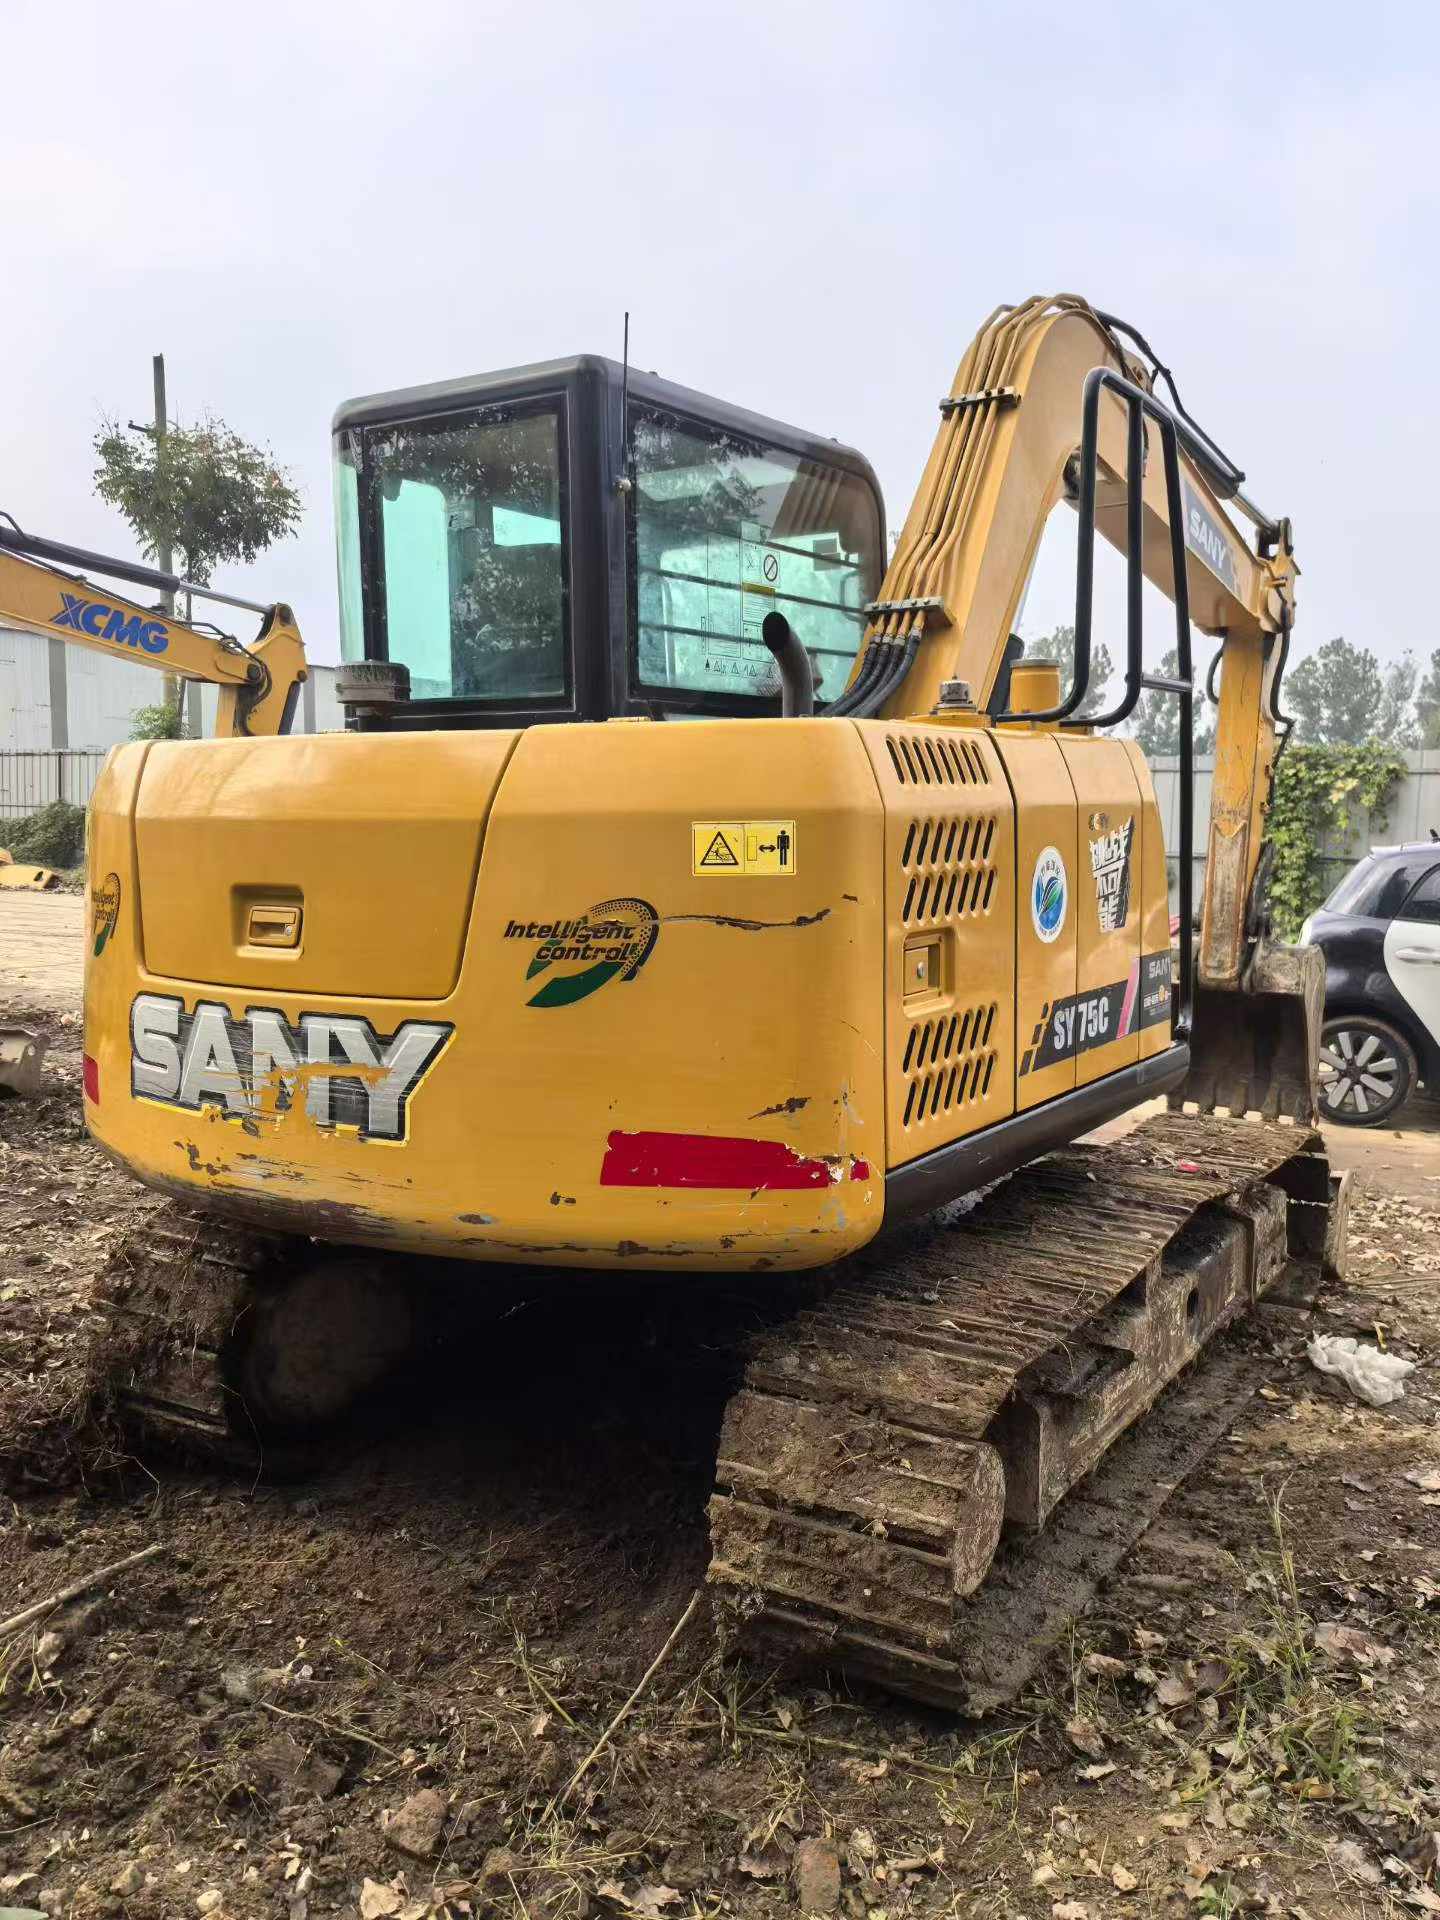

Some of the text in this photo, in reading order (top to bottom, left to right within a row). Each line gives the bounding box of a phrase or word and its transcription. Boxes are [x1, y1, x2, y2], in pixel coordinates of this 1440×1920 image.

[1190, 508, 1226, 569] SANY
[50, 592, 169, 654] XCMG
[503, 920, 636, 943] Intelligent
[536, 942, 634, 961] control
[1053, 996, 1109, 1050] SY 75C
[131, 992, 453, 1143] SANY
